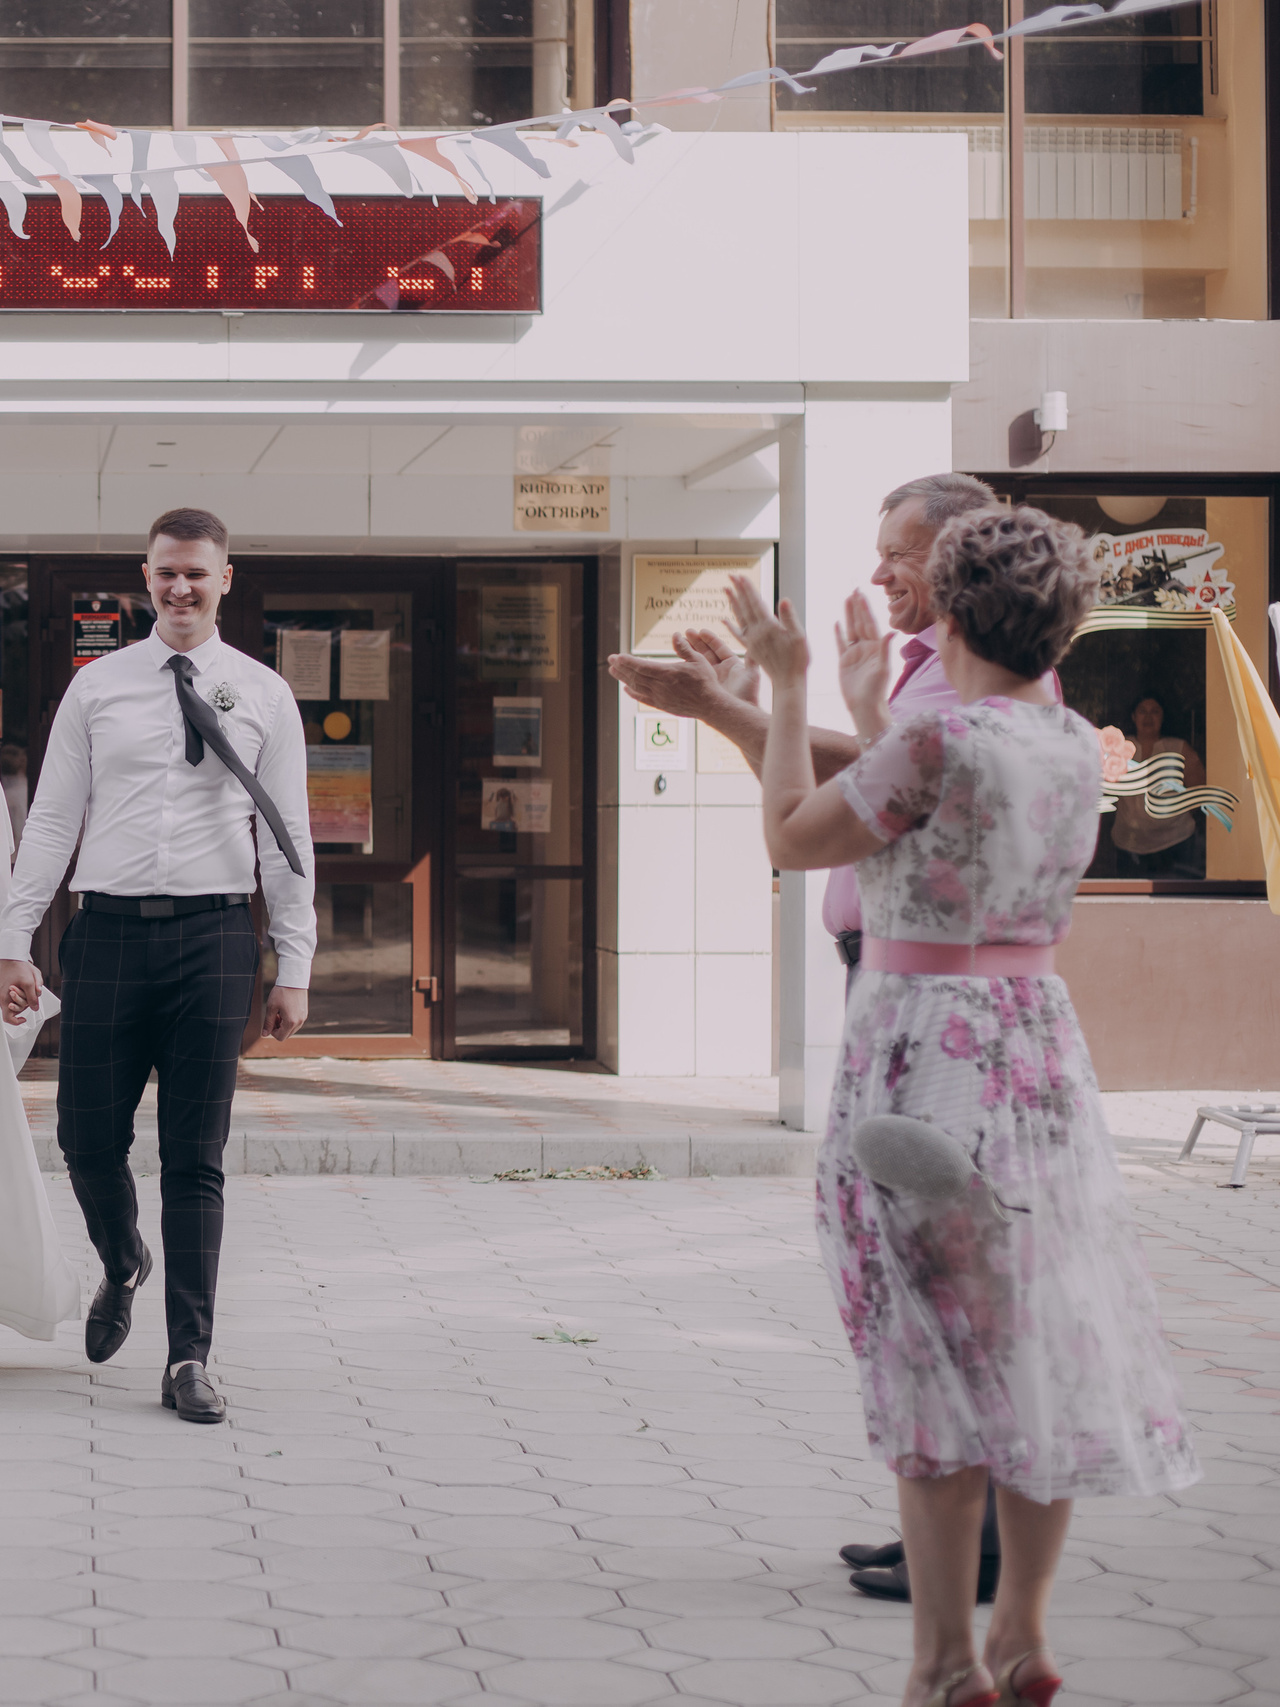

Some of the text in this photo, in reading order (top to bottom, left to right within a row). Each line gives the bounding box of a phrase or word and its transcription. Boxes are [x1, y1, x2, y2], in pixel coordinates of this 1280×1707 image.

[519, 482, 605, 495] КИНОТЕАТР
[517, 505, 608, 519] "ОКТЯБРЬ"
[1112, 534, 1206, 557] С ДНЕМ ПОБЕДЫ!
[645, 596, 674, 611] Дом
